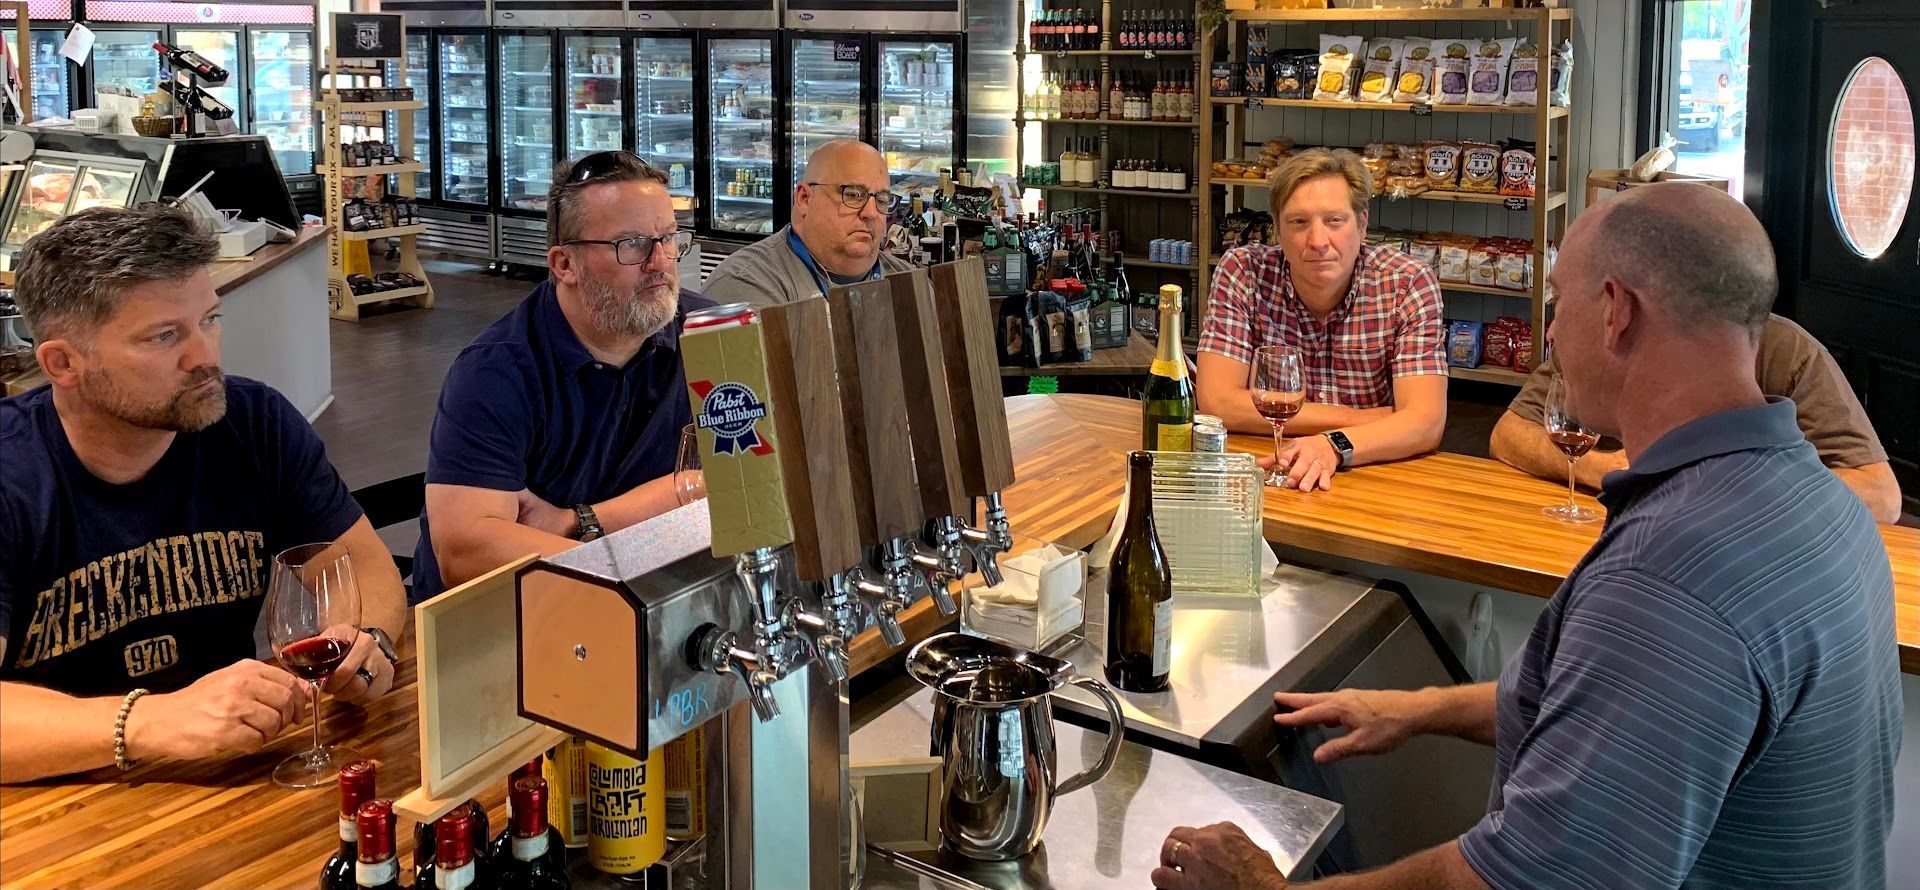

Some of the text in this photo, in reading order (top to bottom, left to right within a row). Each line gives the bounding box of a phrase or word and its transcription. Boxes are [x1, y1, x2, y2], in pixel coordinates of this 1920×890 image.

[332, 248, 338, 266] WE
[711, 392, 745, 411] Pabst
[698, 407, 764, 428] Blue Ribbon
[15, 531, 266, 669] BRECKENRIDGE
[131, 639, 174, 672] 970
[670, 682, 709, 728] PBR
[589, 763, 647, 790] COLUMBIA
[590, 788, 647, 817] CRAFT
